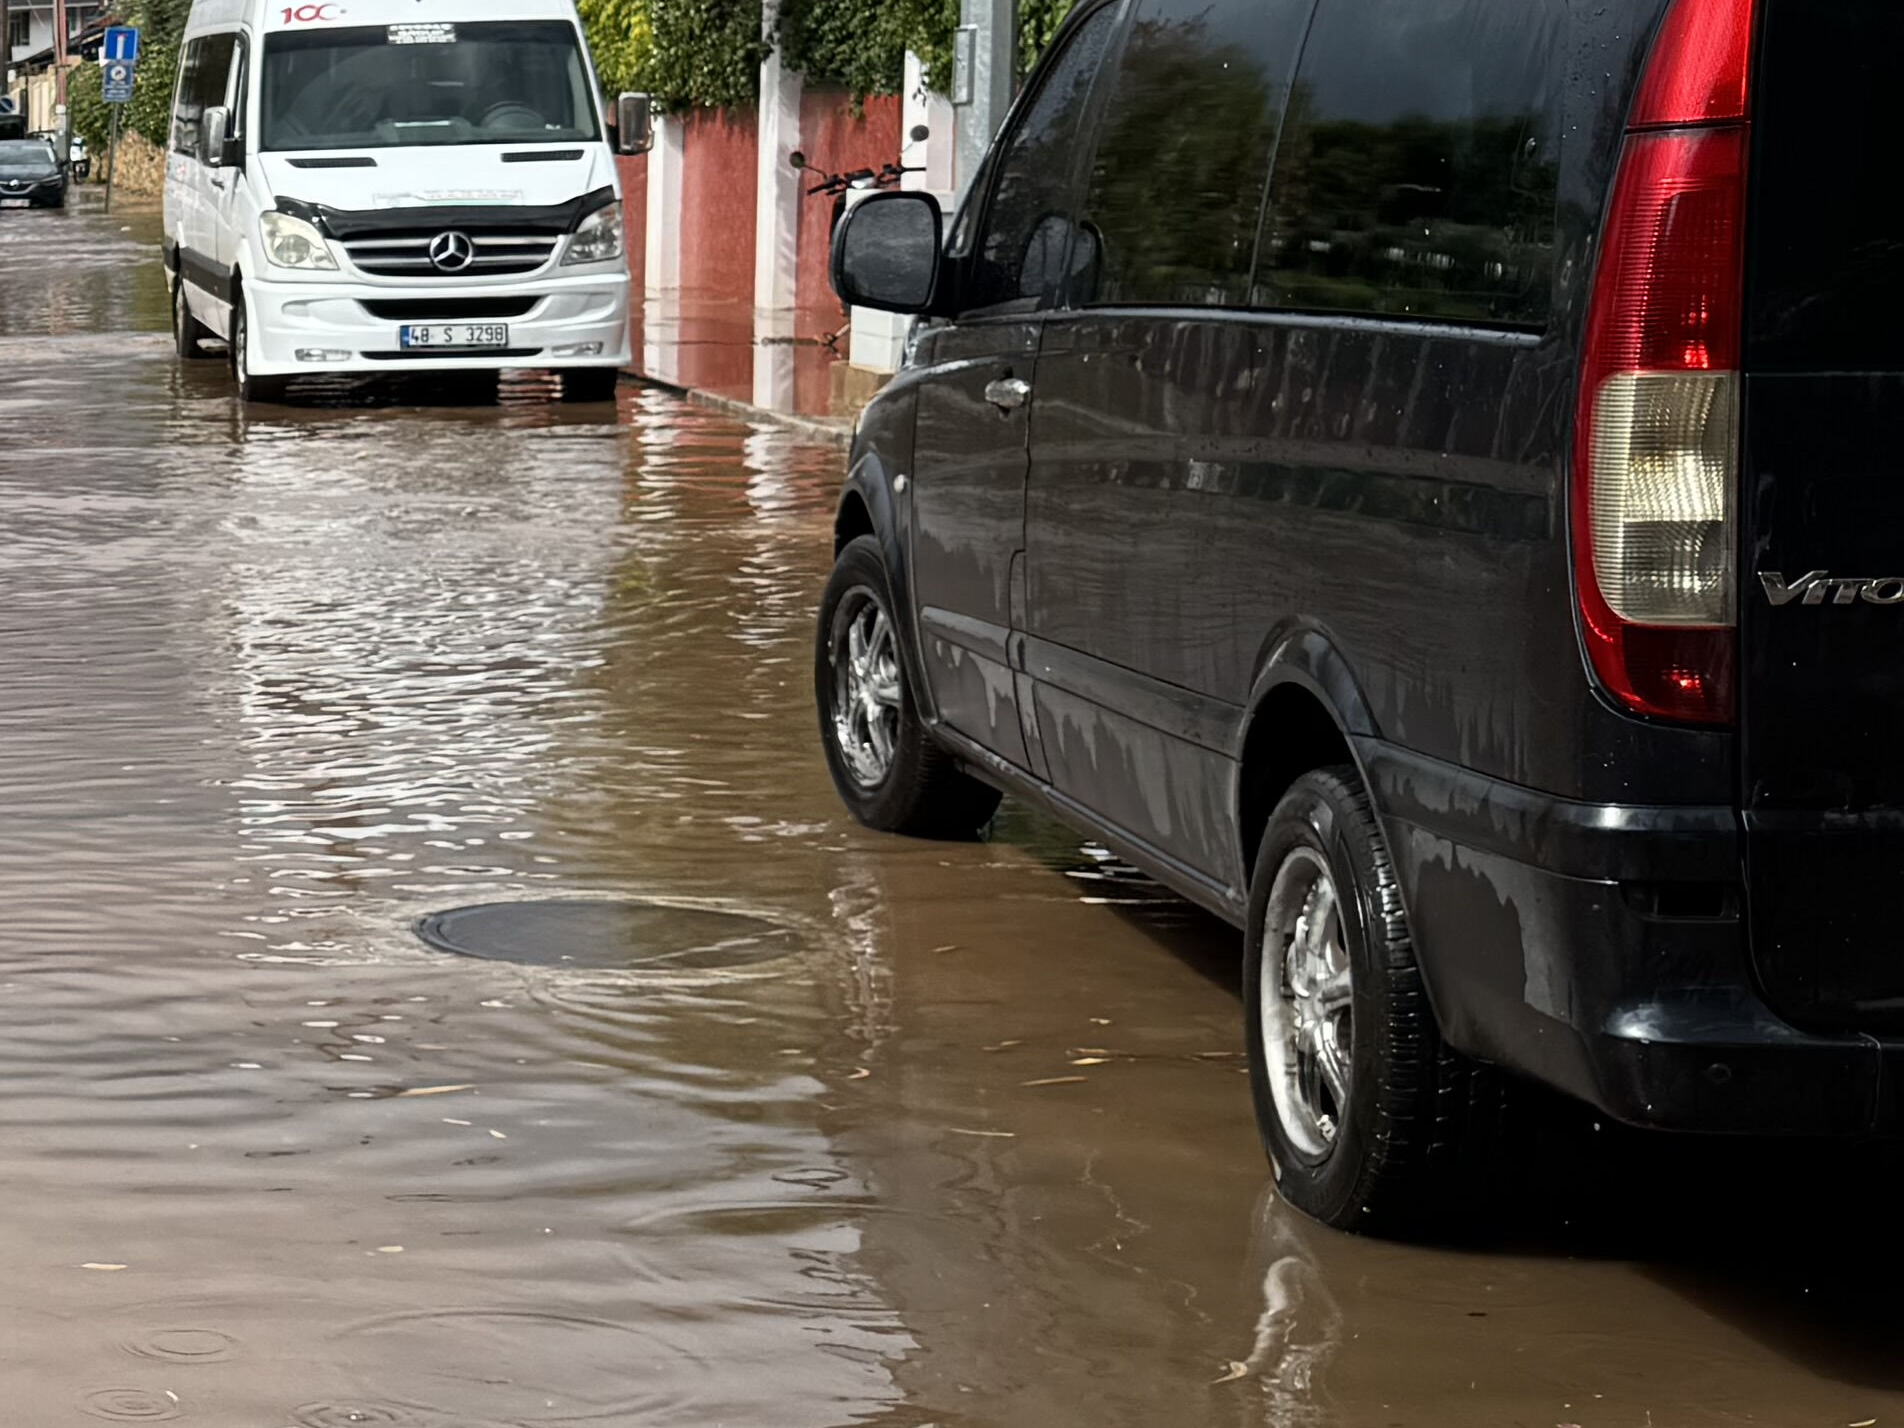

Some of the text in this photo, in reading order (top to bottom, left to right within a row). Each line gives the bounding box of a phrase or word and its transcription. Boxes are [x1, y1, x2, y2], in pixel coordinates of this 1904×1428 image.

[410, 326, 504, 343] 48 S 3298
